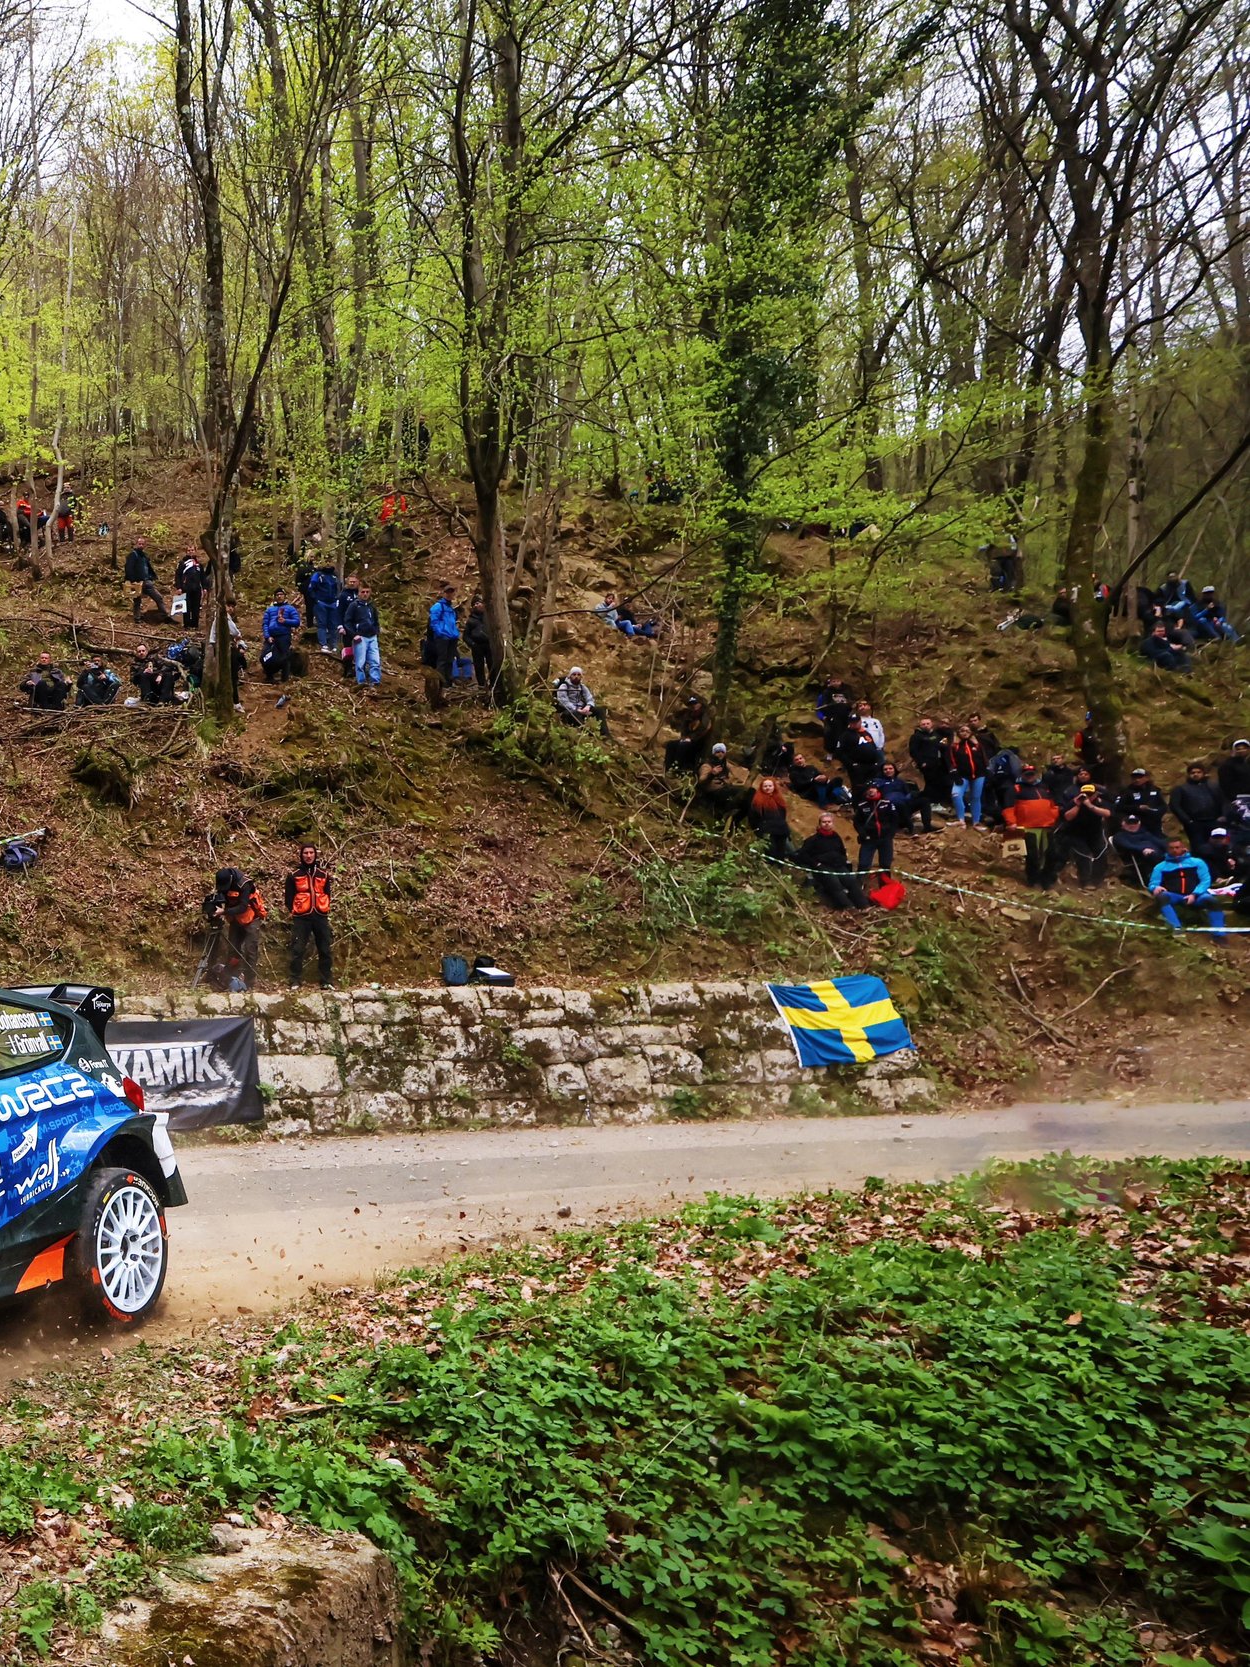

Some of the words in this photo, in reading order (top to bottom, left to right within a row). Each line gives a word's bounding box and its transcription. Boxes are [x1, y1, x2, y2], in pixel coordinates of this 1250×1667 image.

[6, 1034, 18, 1055] J
[14, 1030, 51, 1054] Grönvall
[20, 1180, 52, 1206] LUBRICANTS
